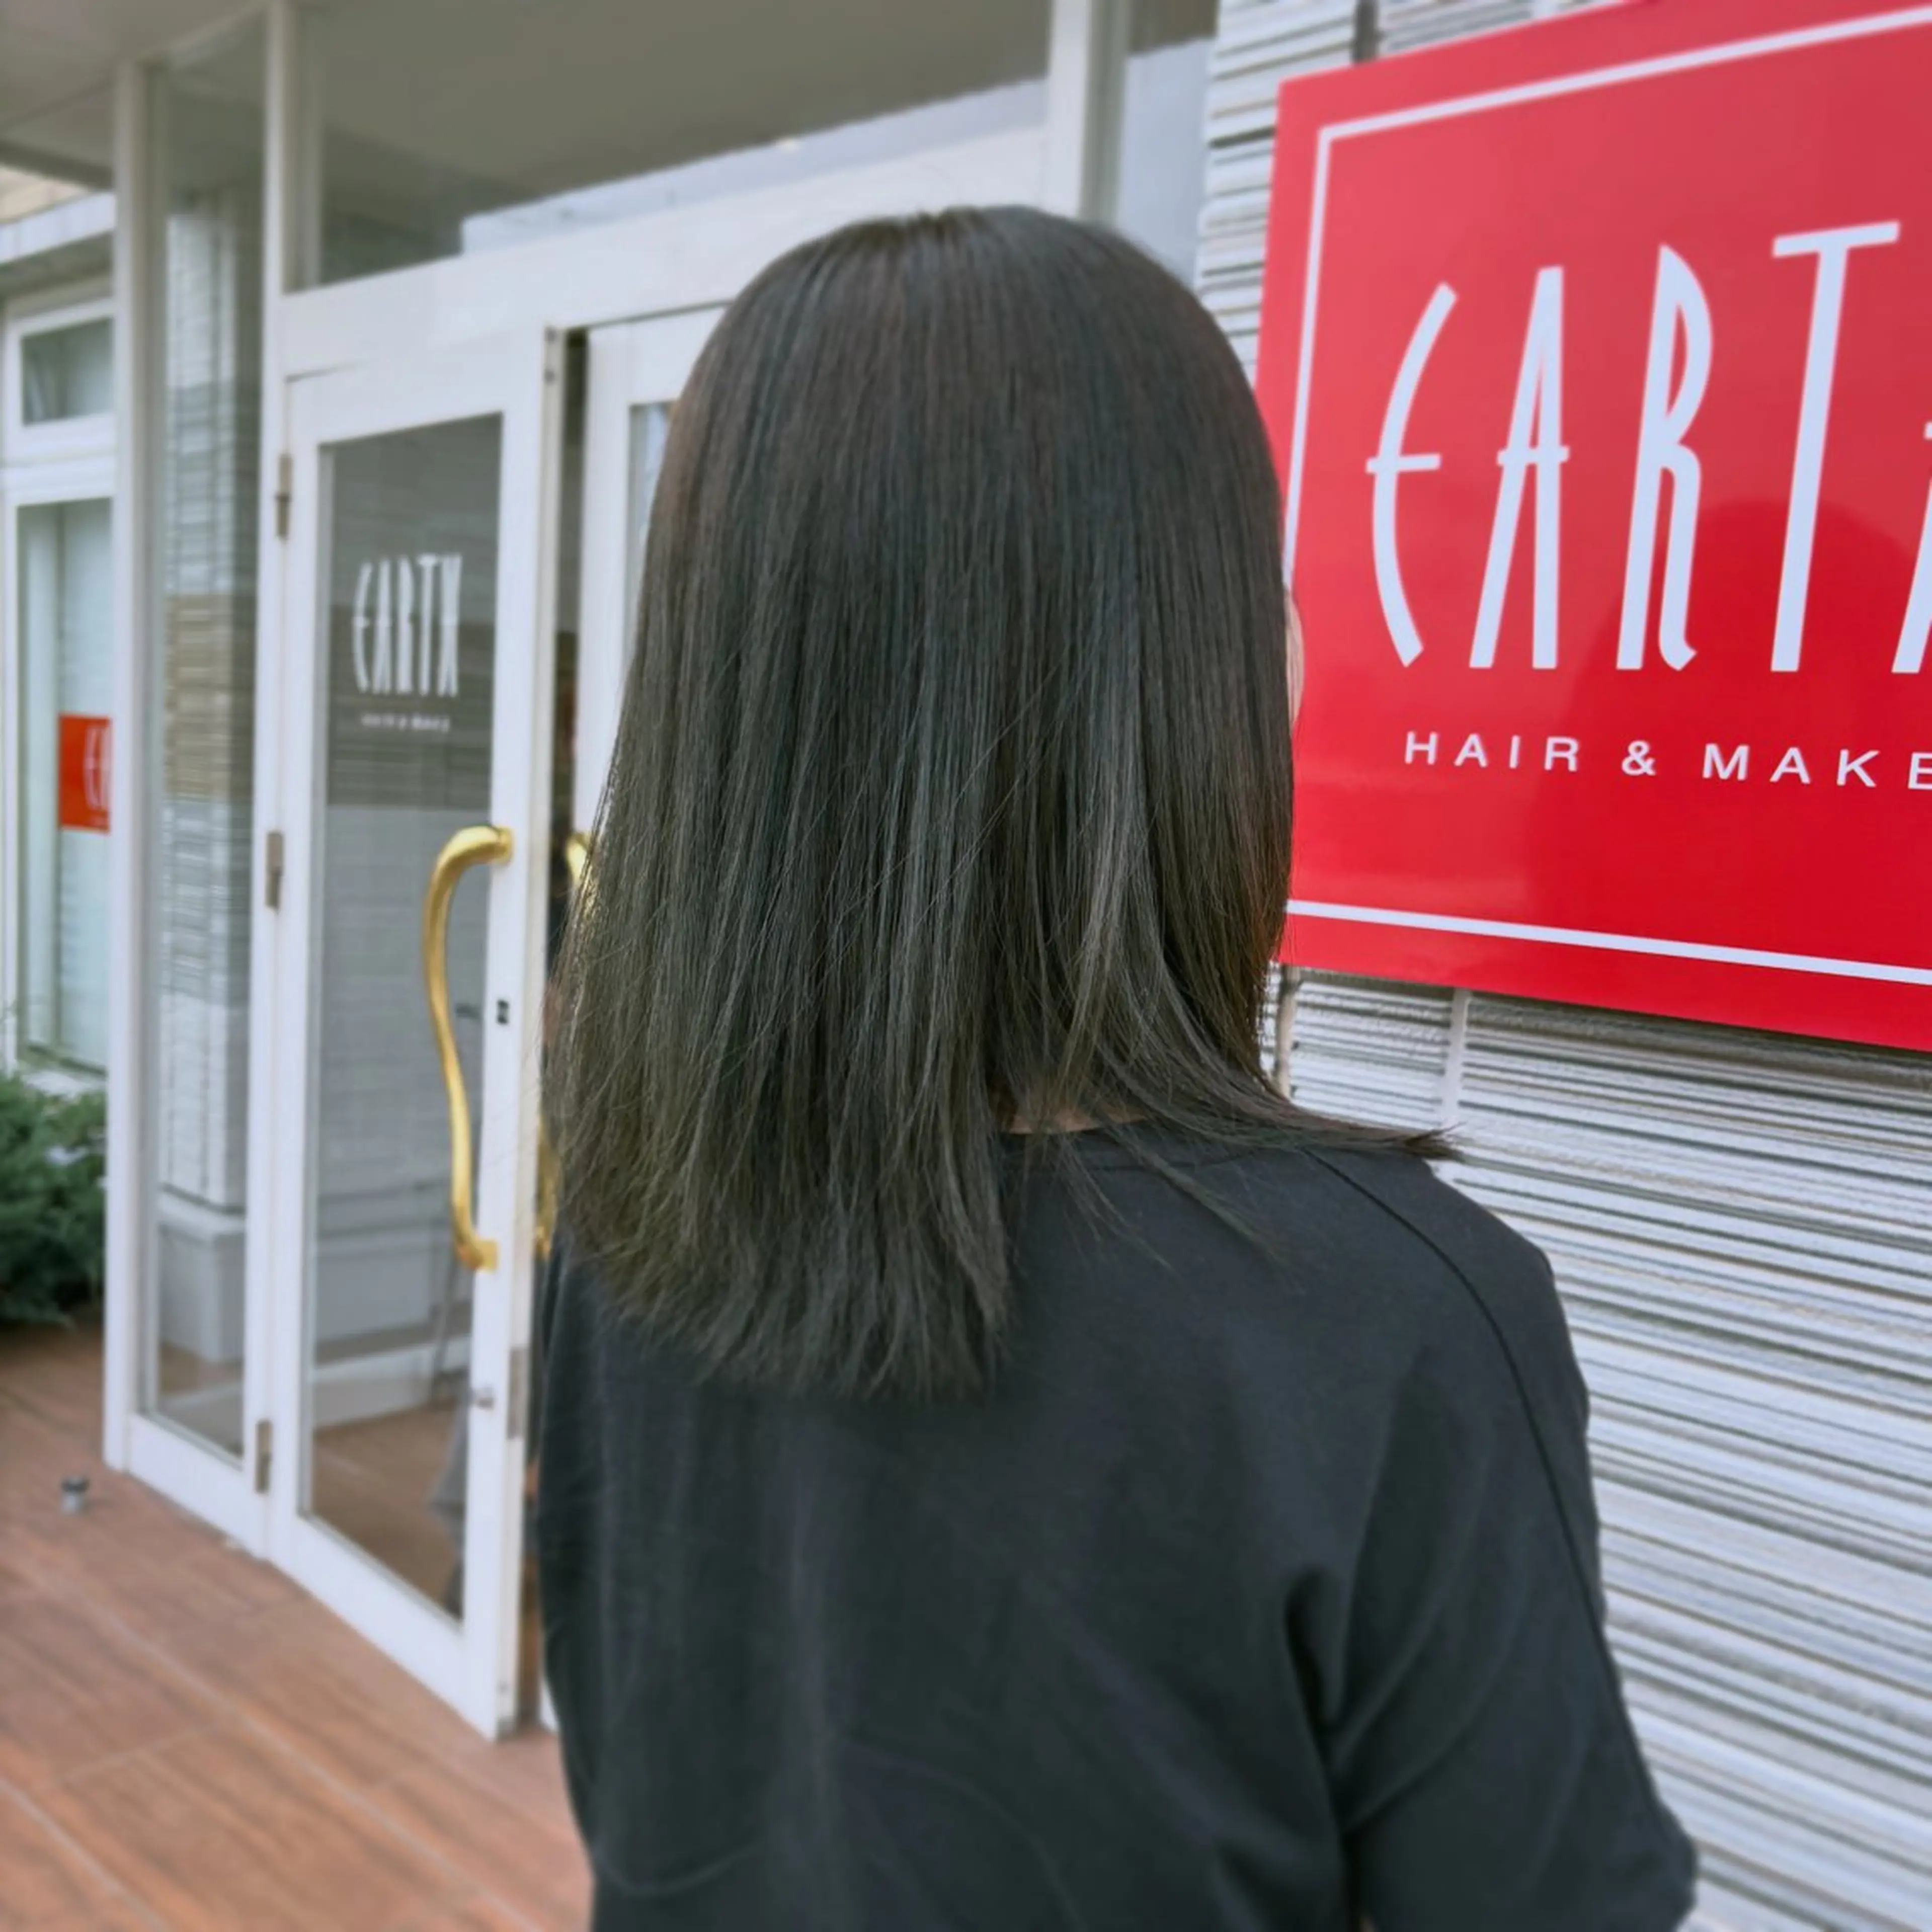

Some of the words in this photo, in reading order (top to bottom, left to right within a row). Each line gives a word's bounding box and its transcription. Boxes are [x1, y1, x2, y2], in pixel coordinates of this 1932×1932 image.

[1365, 220, 1932, 674] EART
[1404, 731, 1579, 772] HAIR
[1621, 740, 1656, 776] &
[1702, 742, 1932, 790] MAKE
